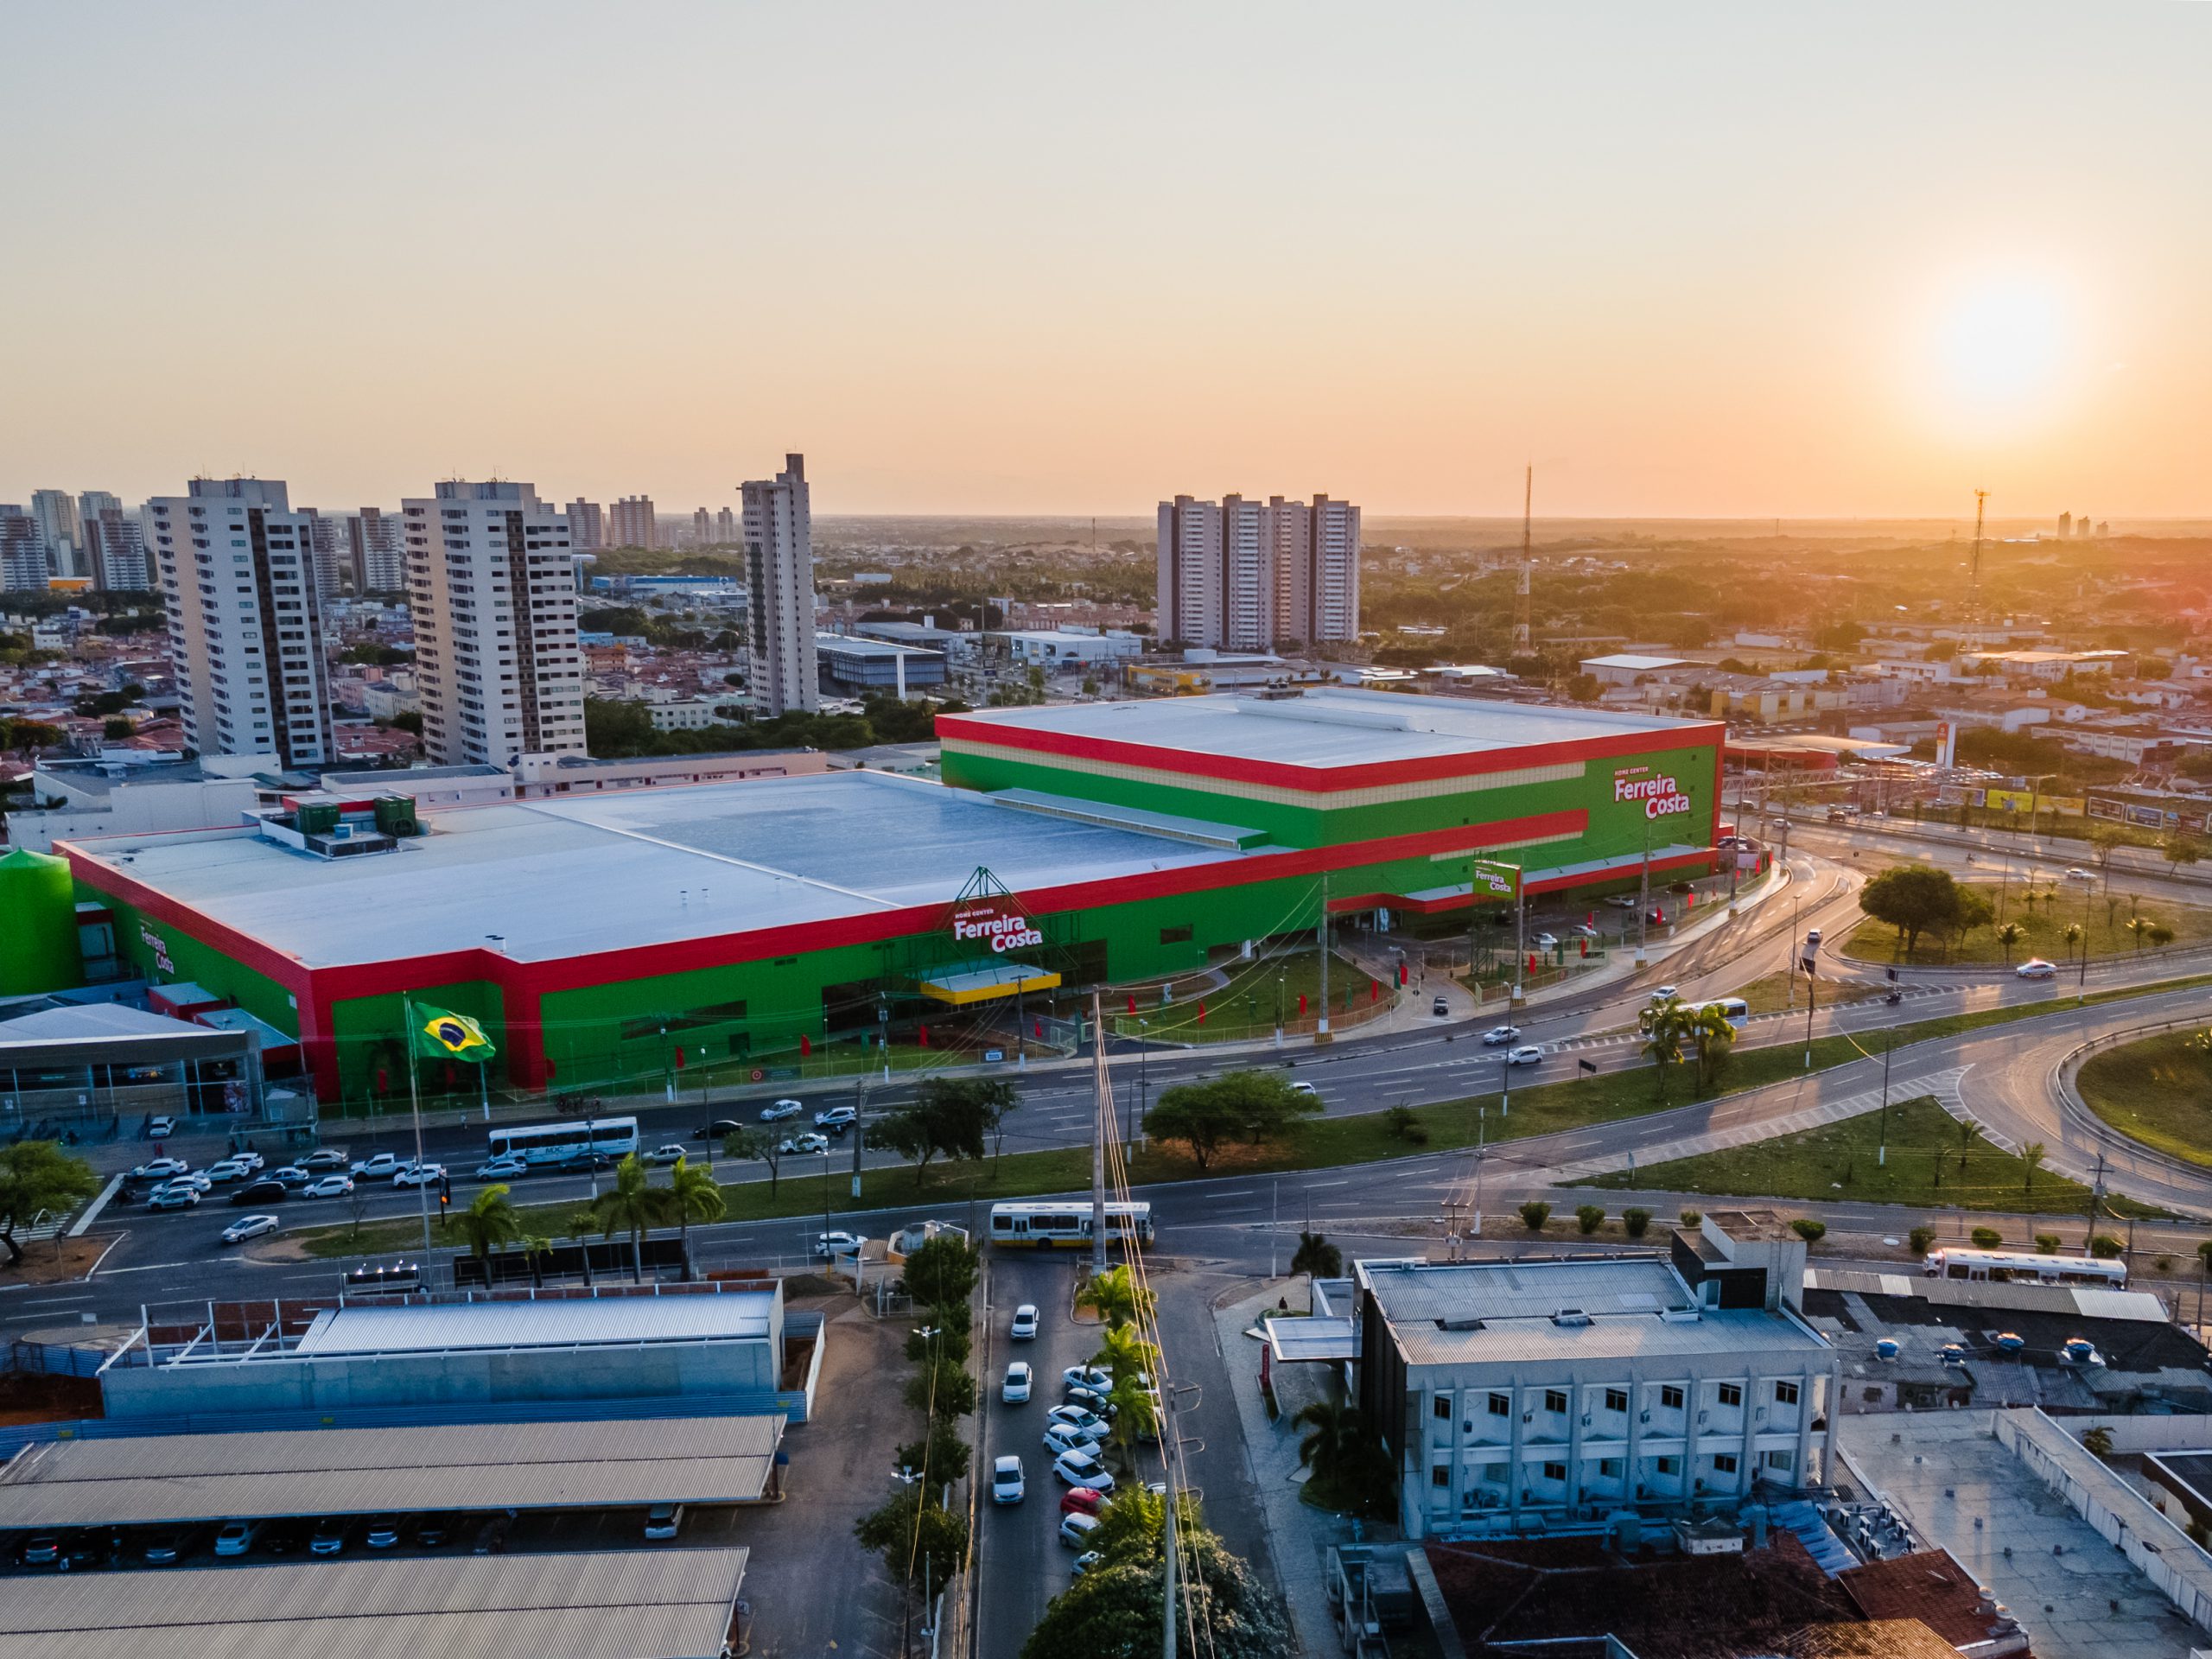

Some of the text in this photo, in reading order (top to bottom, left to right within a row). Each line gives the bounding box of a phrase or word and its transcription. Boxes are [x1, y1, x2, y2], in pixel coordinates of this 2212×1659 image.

[1614, 773, 1676, 802] Ferreira
[1645, 793, 1690, 819] Costa
[1476, 869, 1504, 883] Ferreira
[1490, 881, 1511, 893] Costa
[955, 908, 994, 918] HOME CENTER
[954, 914, 1026, 940] Ferreira
[140, 925, 167, 955] Ferreira
[991, 929, 1043, 953] Costa
[156, 951, 175, 975] Costa
